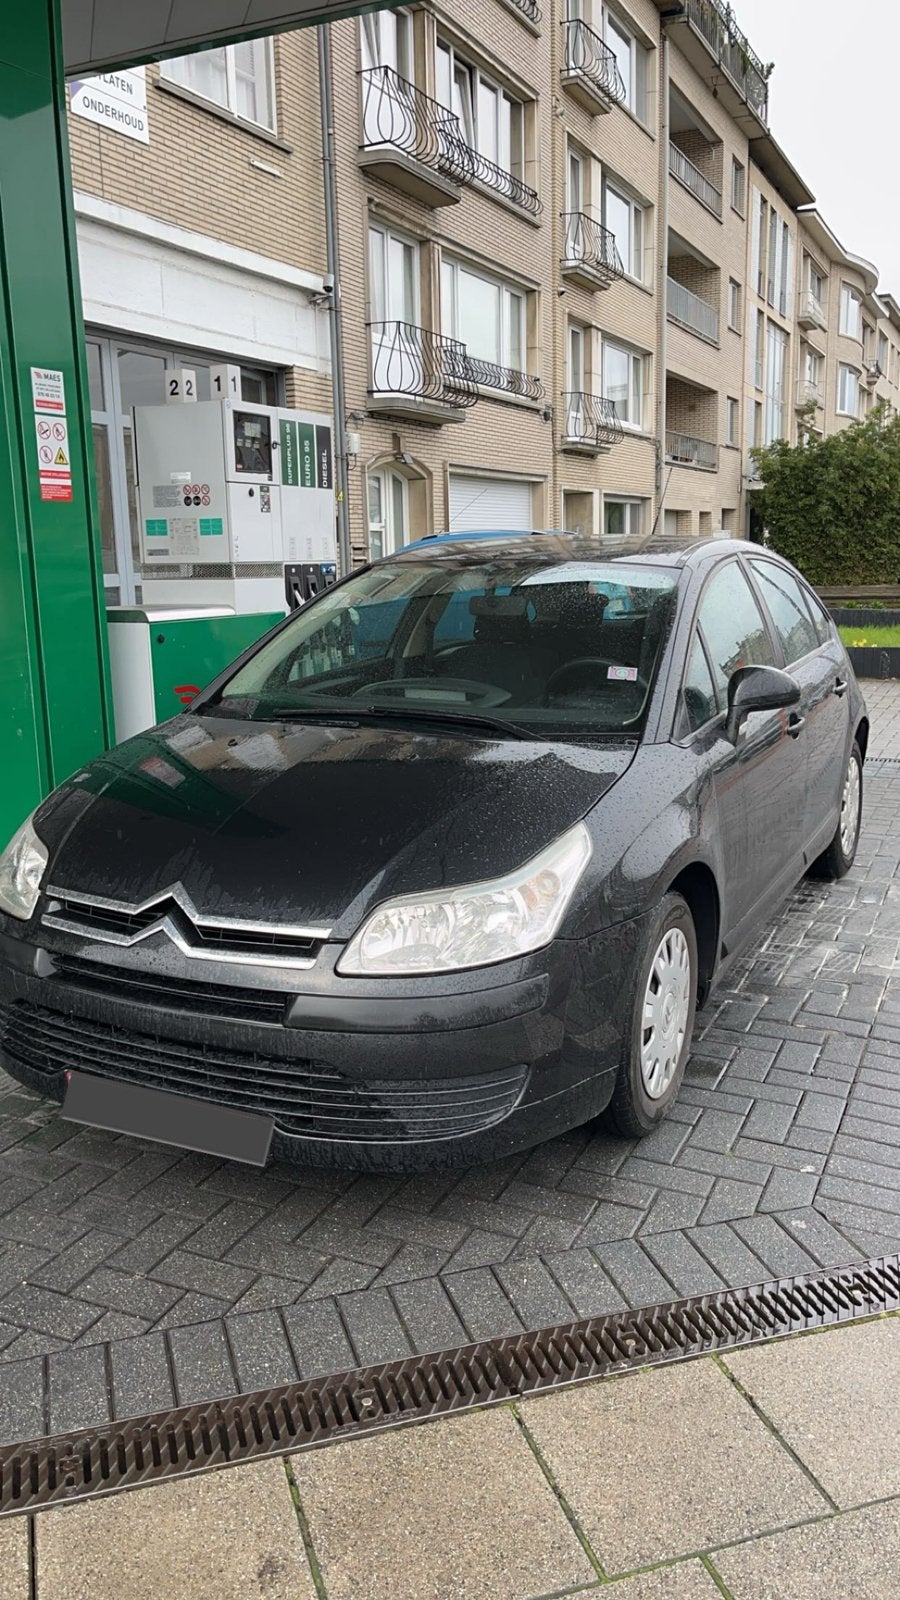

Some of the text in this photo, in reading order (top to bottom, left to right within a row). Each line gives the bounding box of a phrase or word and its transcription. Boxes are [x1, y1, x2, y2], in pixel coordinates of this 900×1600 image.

[82, 95, 144, 131] ONDERHOUD
[43, 373, 61, 382] MAES
[213, 375, 221, 392] 1
[231, 375, 237, 393] 1
[169, 379, 179, 396] 2
[185, 379, 193, 396] 2
[303, 440, 310, 453] 95
